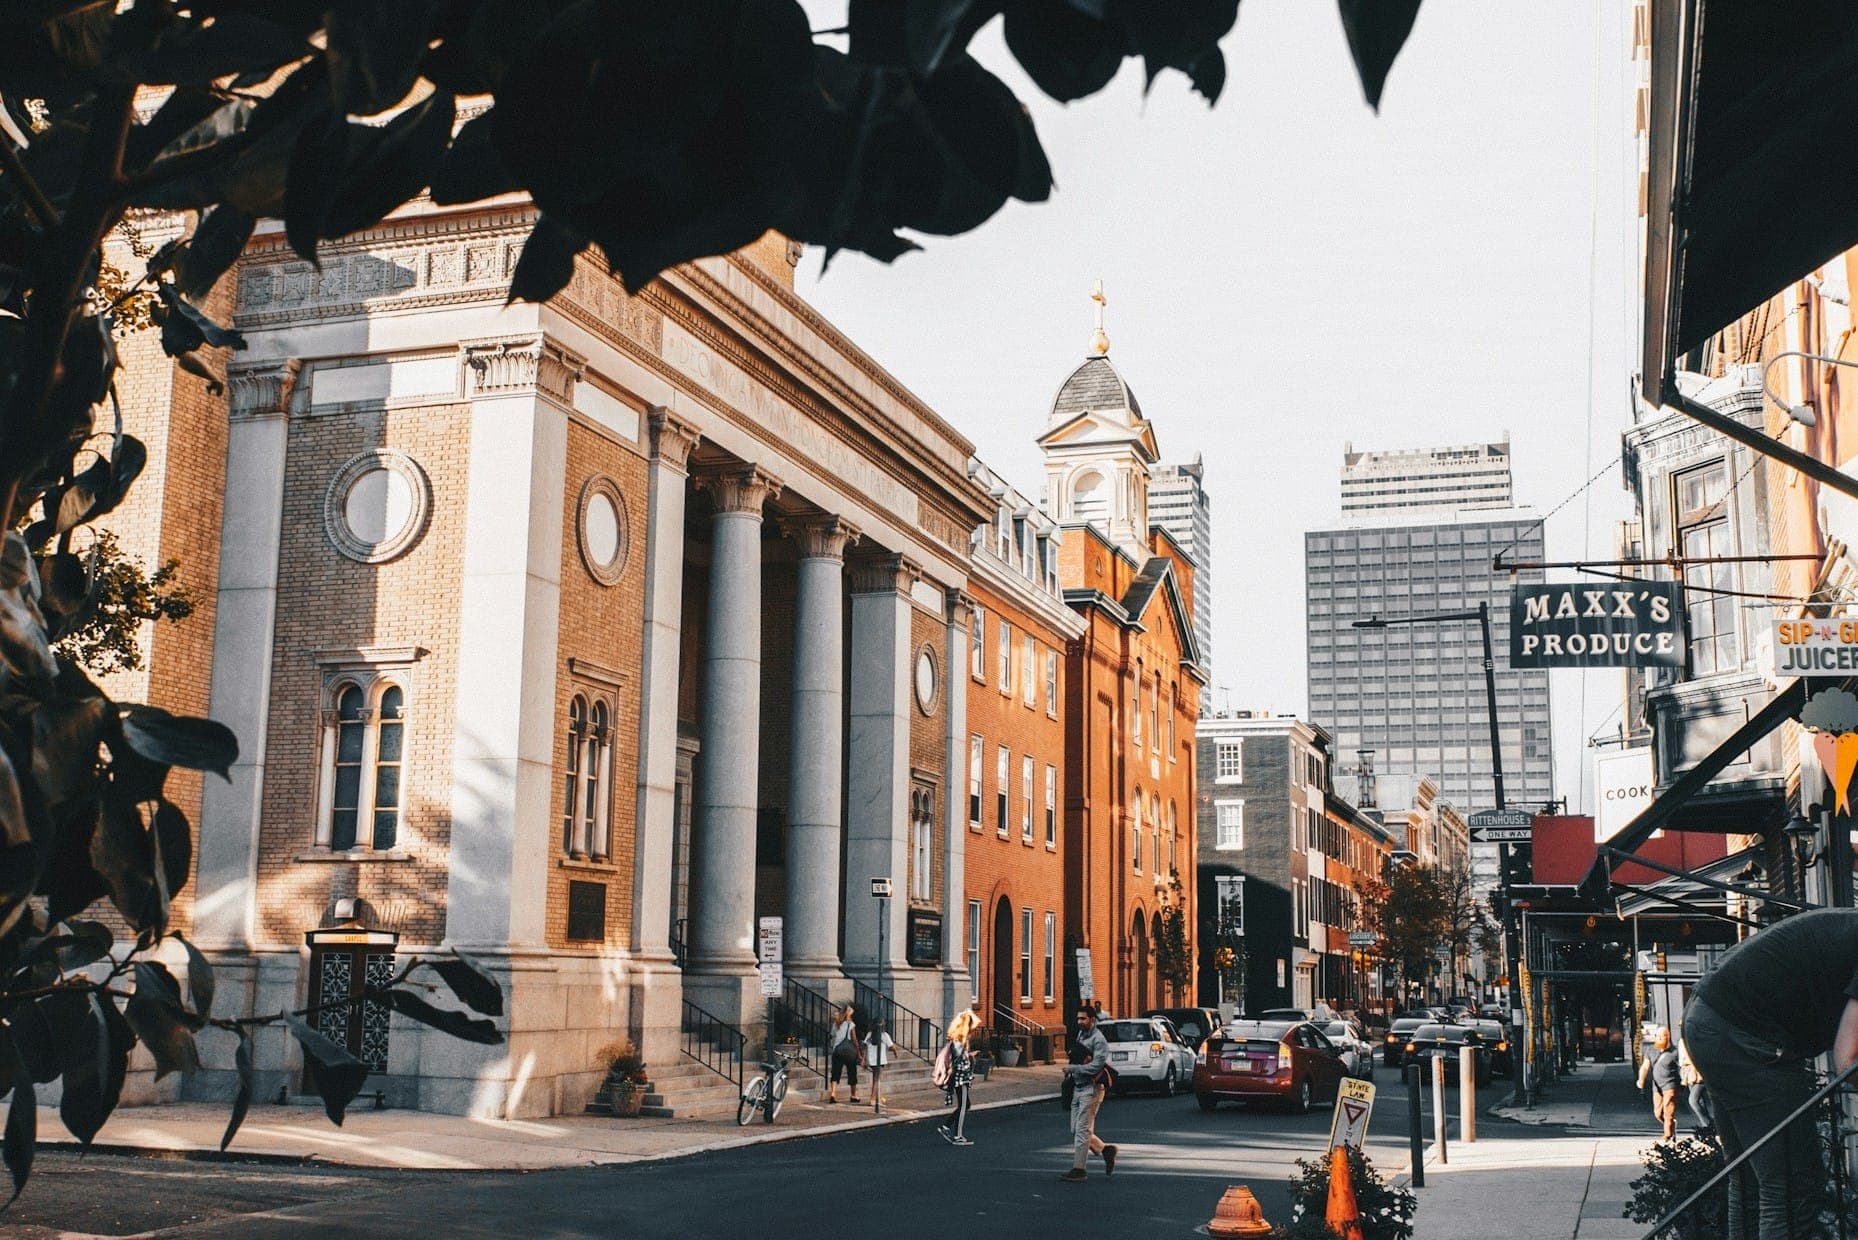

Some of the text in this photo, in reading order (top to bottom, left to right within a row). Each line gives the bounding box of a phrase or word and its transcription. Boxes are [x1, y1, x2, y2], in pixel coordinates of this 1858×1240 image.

[1523, 591, 1670, 625] MAXX'S
[1521, 632, 1674, 655] PRODUCE
[1606, 785, 1648, 800] COOK
[1470, 815, 1525, 825] RITTENHOUSE
[1348, 1081, 1370, 1092] STATE
[1349, 1091, 1365, 1099] LAW
